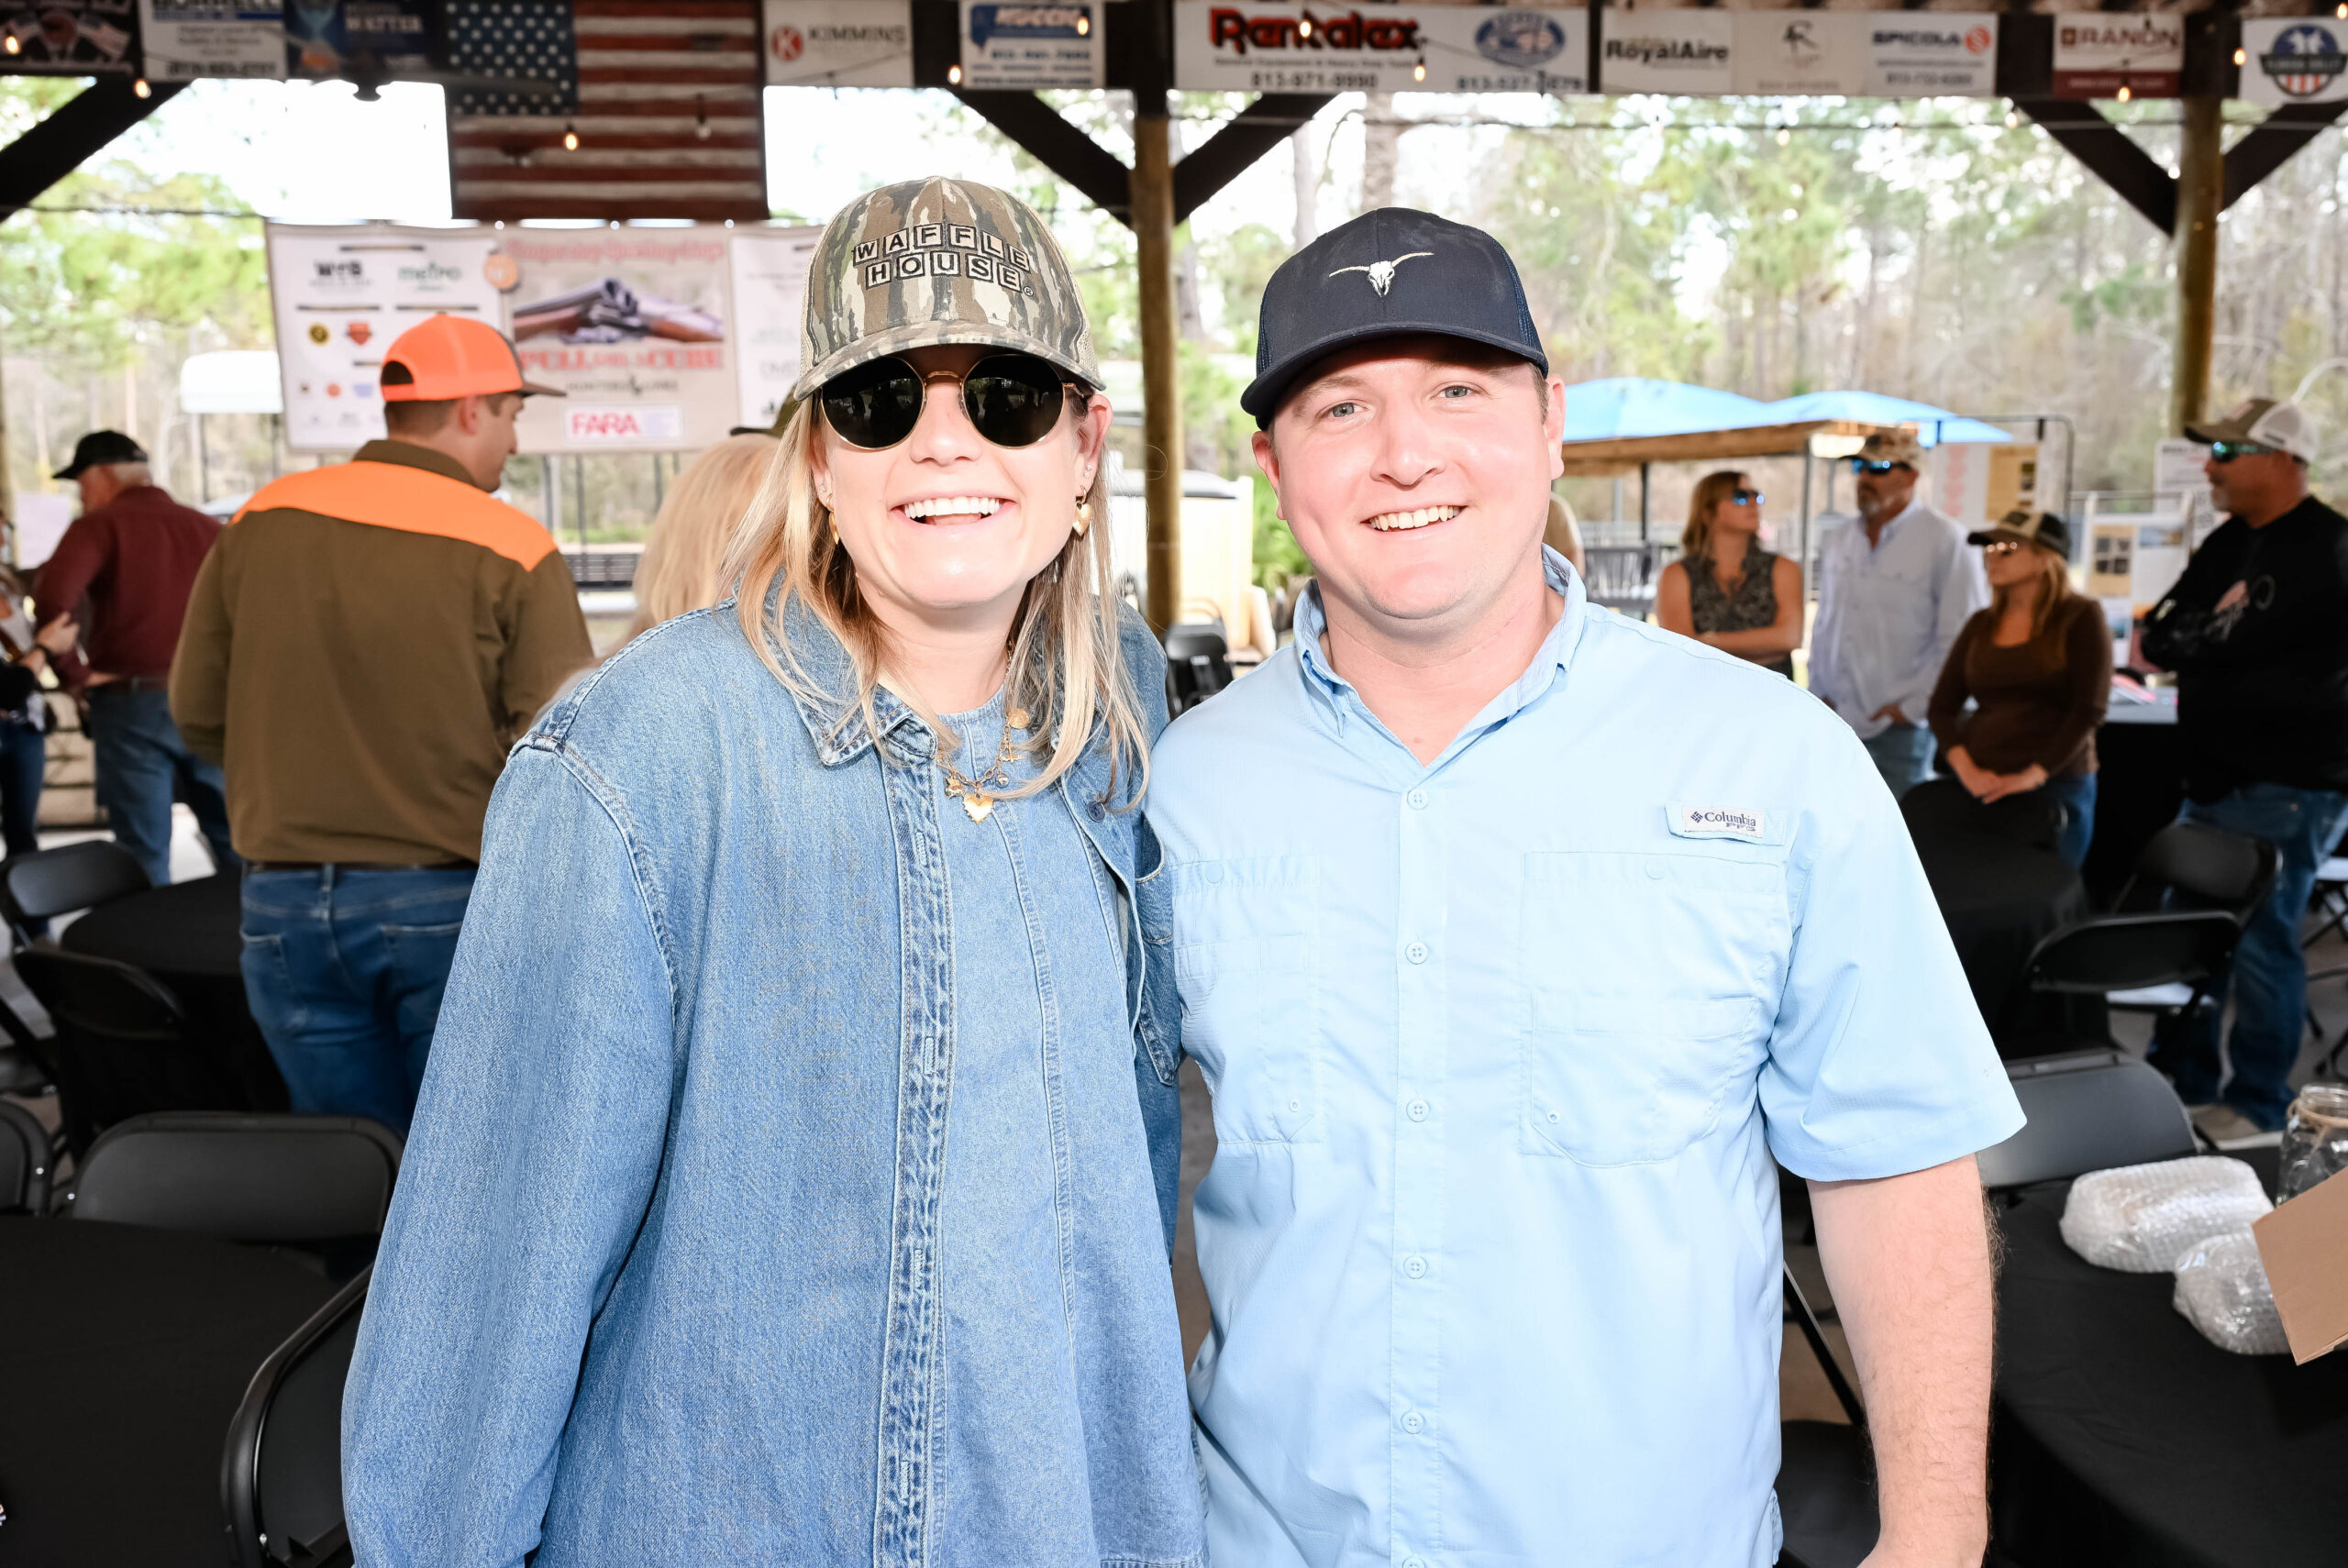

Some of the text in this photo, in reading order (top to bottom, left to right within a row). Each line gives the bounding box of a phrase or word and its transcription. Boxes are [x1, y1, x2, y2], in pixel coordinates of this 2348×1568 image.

[808, 25, 907, 43] KIMMINS
[1607, 39, 1729, 65] RoyalAire
[853, 224, 1030, 271] WAFFLE
[868, 251, 1022, 292] HOUSE
[570, 413, 641, 436] FARA
[1704, 811, 1756, 827] Columbia
